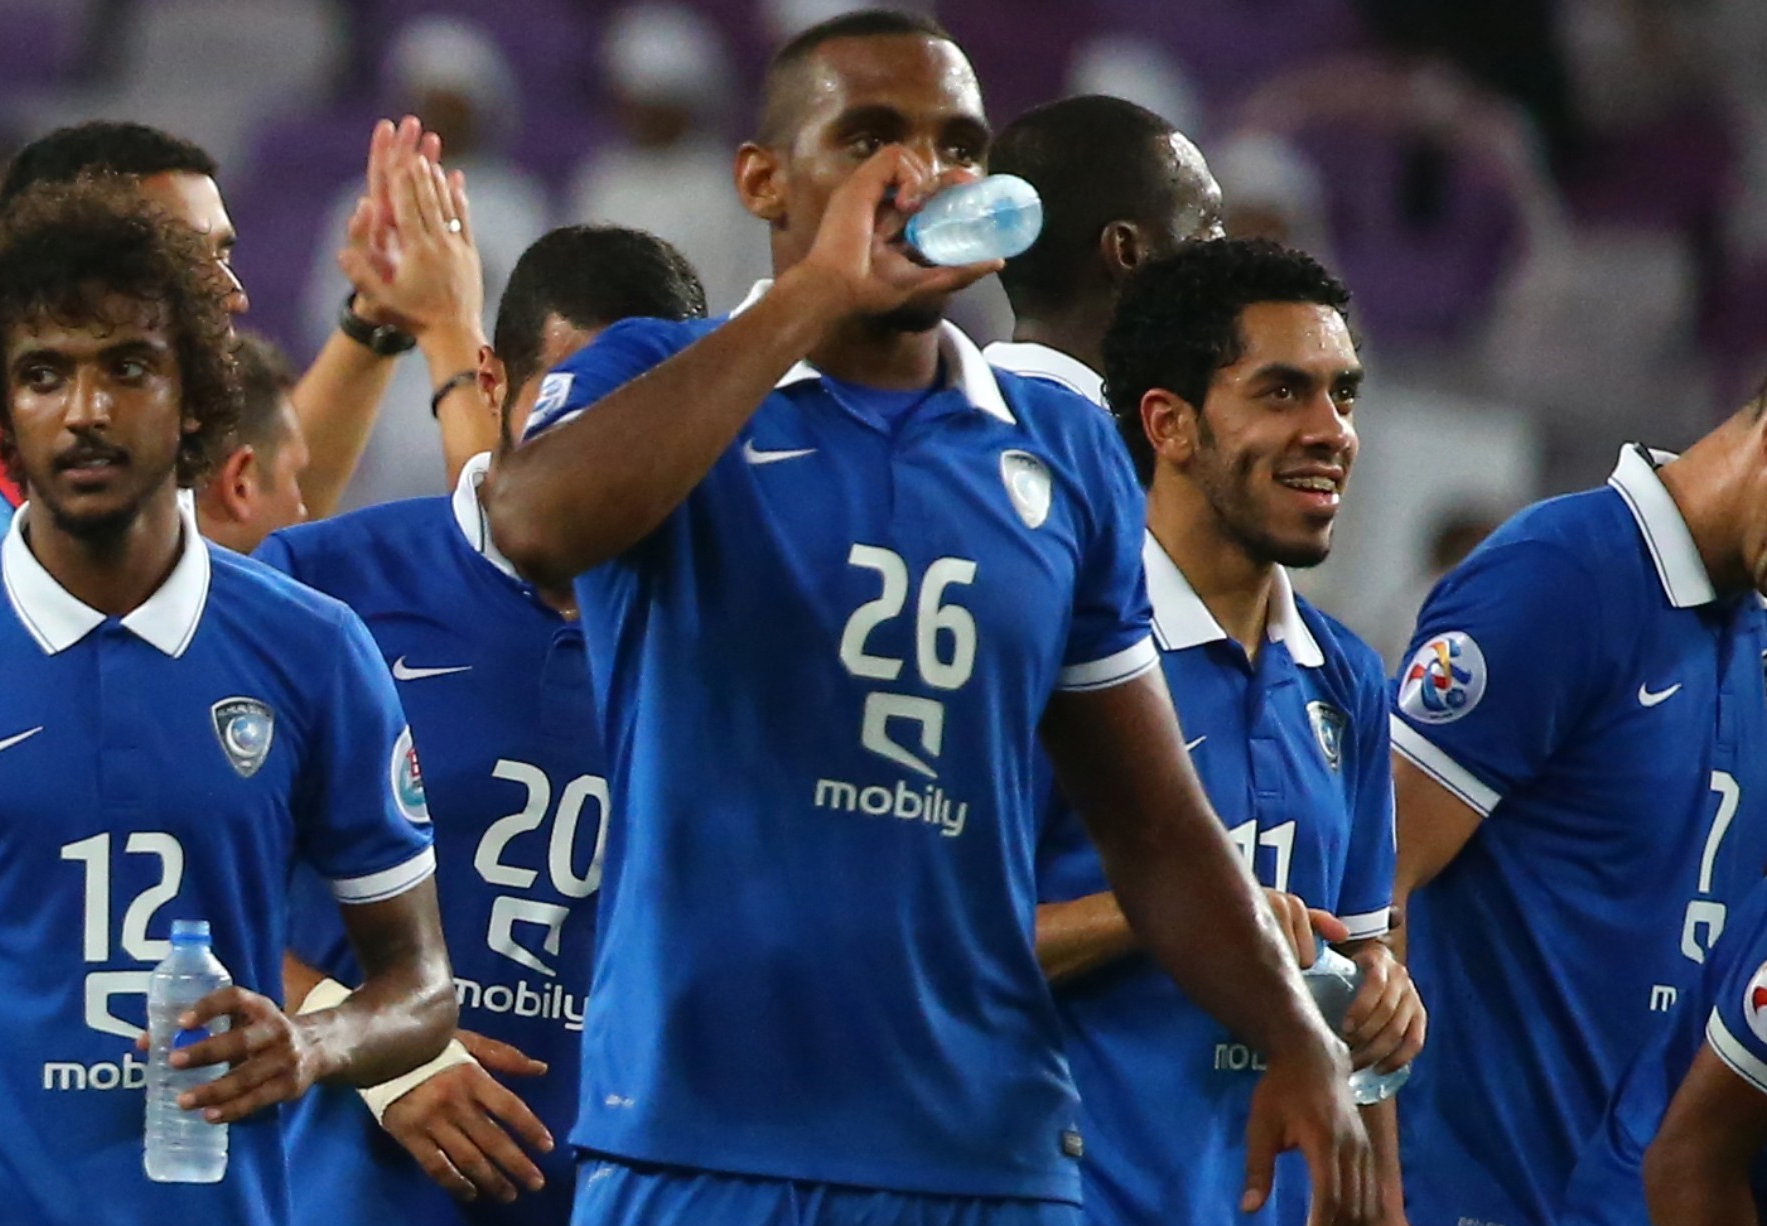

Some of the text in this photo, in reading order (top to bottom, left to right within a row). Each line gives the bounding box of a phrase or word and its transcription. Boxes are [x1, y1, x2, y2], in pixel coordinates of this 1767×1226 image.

[840, 543, 977, 689] 26
[474, 758, 610, 898] 20
[815, 779, 968, 837] mobily
[61, 832, 184, 962] 12
[452, 977, 590, 1031] mobily
[44, 1052, 148, 1090] mob
